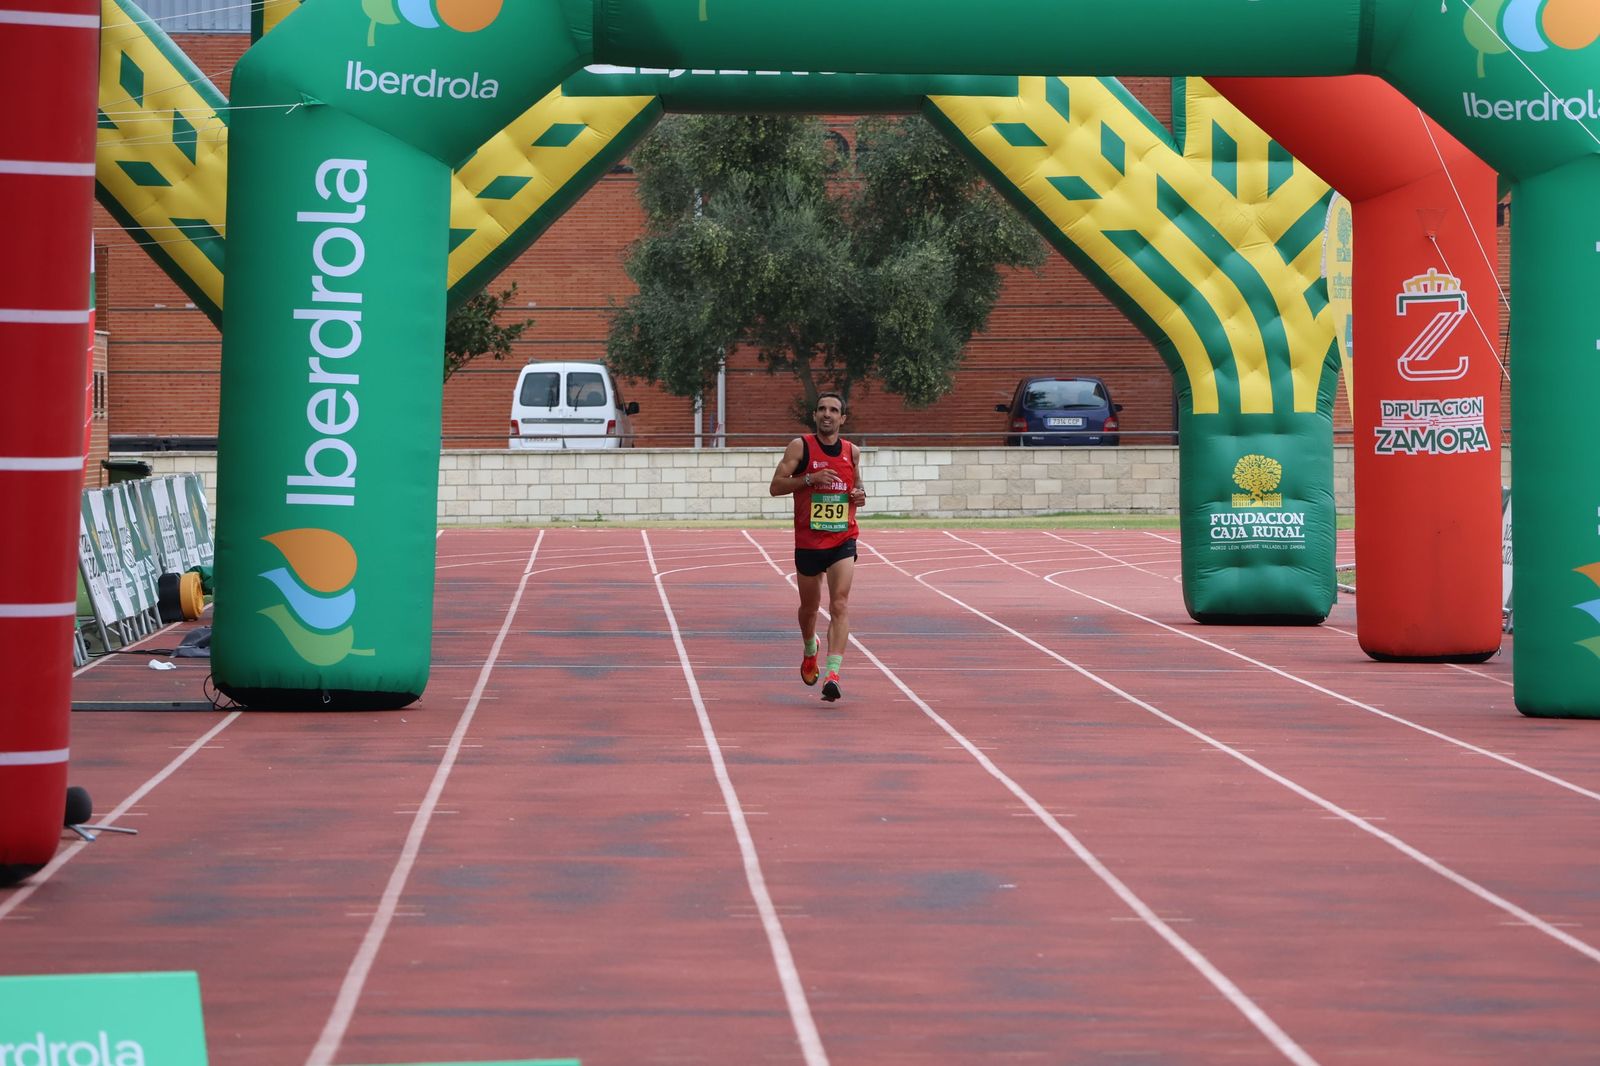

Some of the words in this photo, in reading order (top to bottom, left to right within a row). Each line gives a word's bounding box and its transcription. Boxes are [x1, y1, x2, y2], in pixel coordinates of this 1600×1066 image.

[346, 60, 499, 99] Iberdrola
[1463, 89, 1600, 121] Iberdrol
[286, 158, 368, 506] Iberdrola
[1374, 427, 1491, 455] ZAMORA
[813, 504, 843, 518] 259
[1210, 512, 1305, 526] FUNDACION
[1210, 526, 1249, 539] CAJA
[1252, 526, 1305, 538] RURAL
